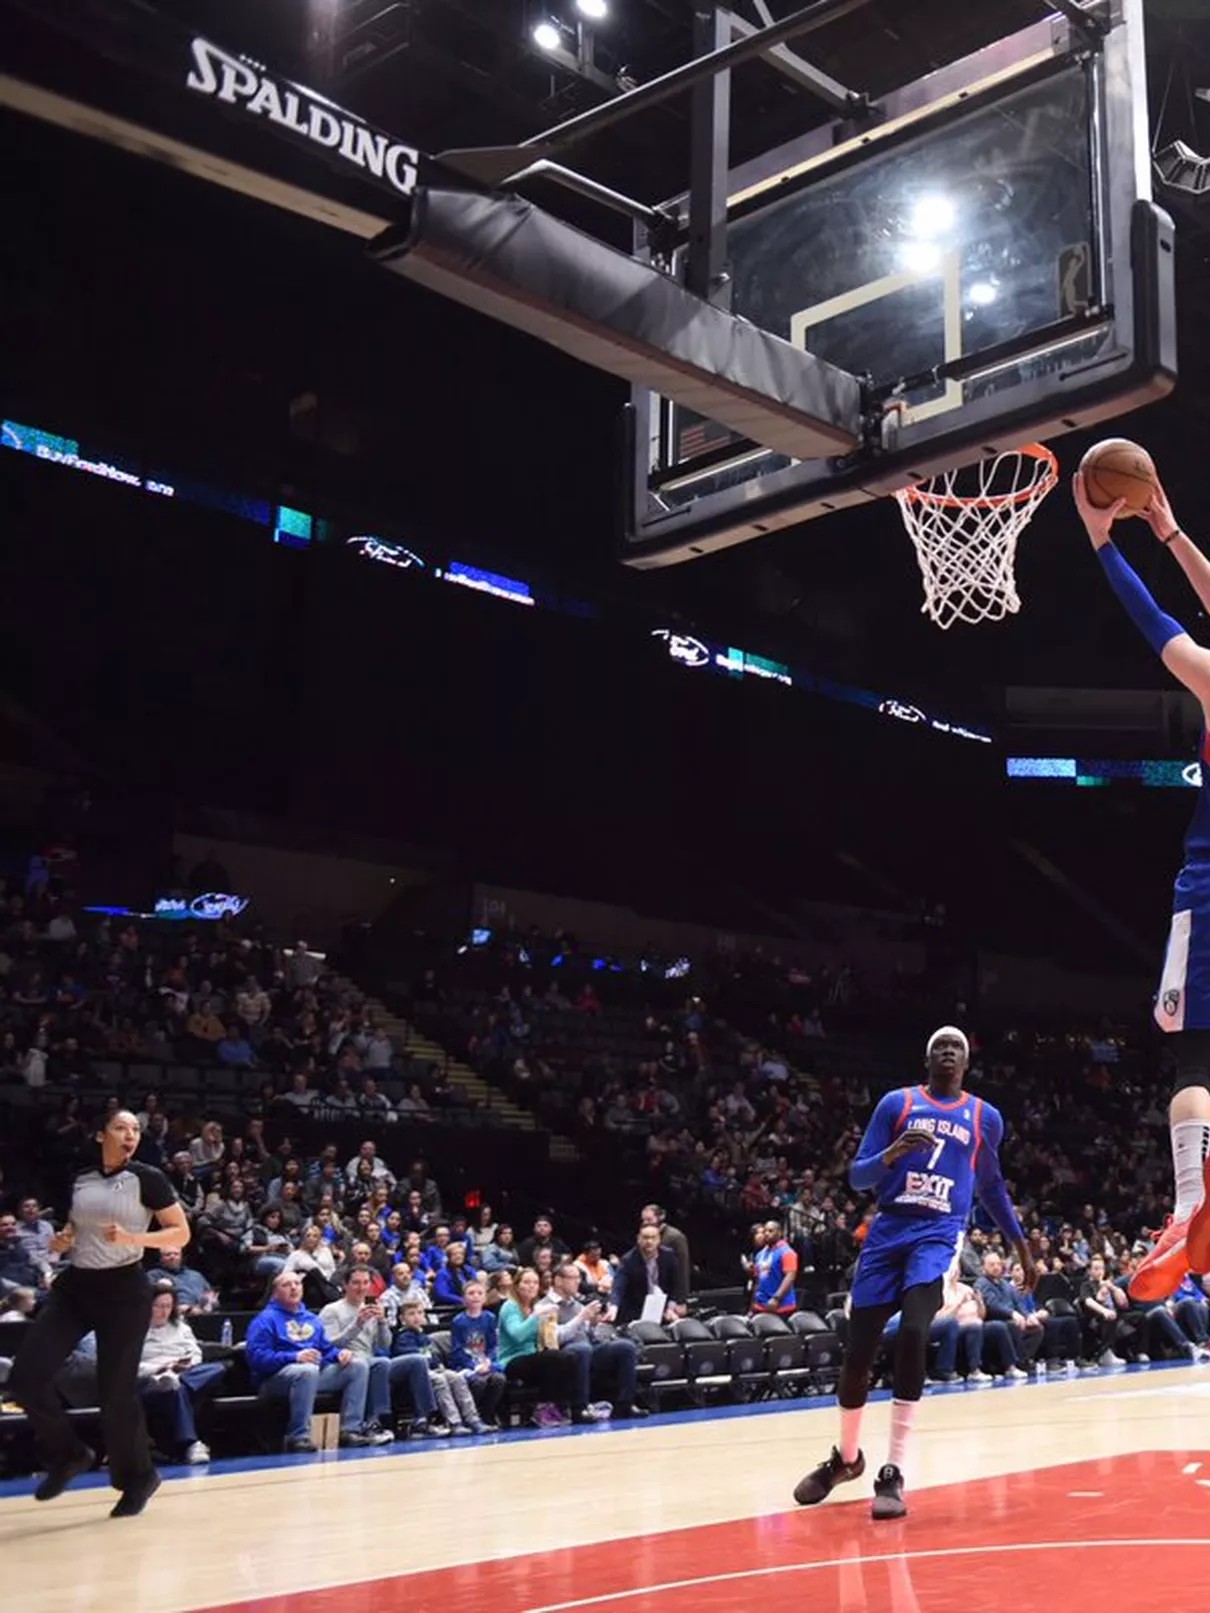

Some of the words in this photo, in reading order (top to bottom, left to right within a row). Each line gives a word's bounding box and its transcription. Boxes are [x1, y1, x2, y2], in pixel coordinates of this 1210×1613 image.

[186, 37, 419, 196] SPALDING
[936, 1119, 971, 1145] ISLAND
[926, 1138, 946, 1170] 7
